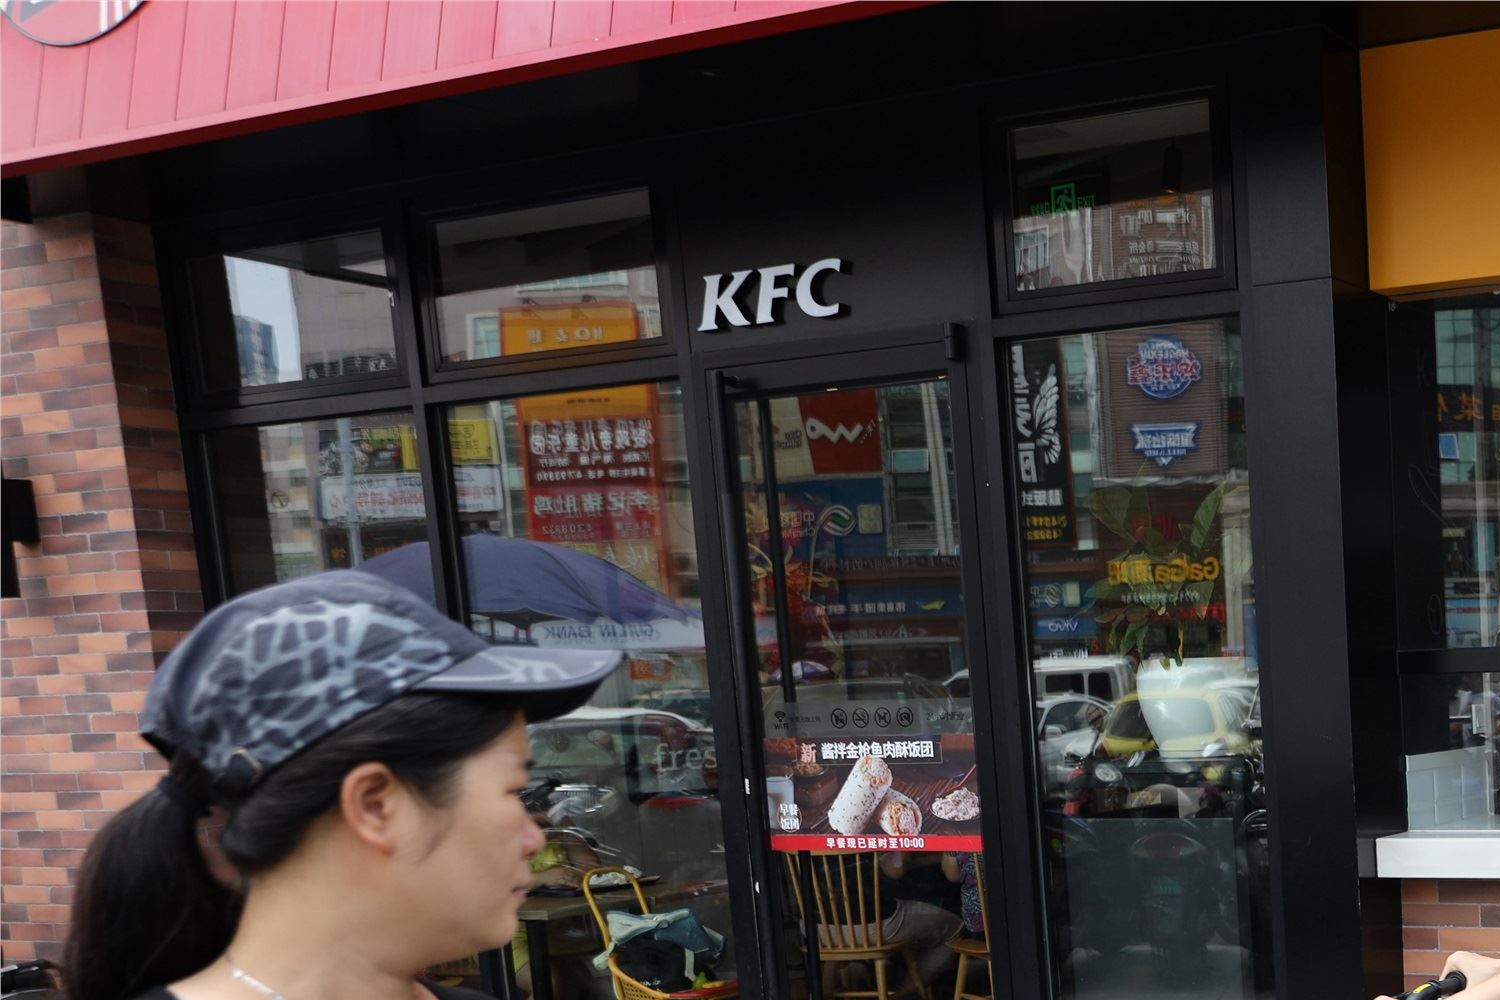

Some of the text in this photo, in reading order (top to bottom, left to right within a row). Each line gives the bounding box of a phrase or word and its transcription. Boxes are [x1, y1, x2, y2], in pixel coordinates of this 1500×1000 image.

[697, 258, 841, 332] KFC
[800, 743, 817, 764] 新
[820, 741, 934, 760] 酱拌金枪鱼肉酥饭团
[779, 803, 799, 817] 早餐
[825, 837, 925, 850] 早餐现已延时至10:00
